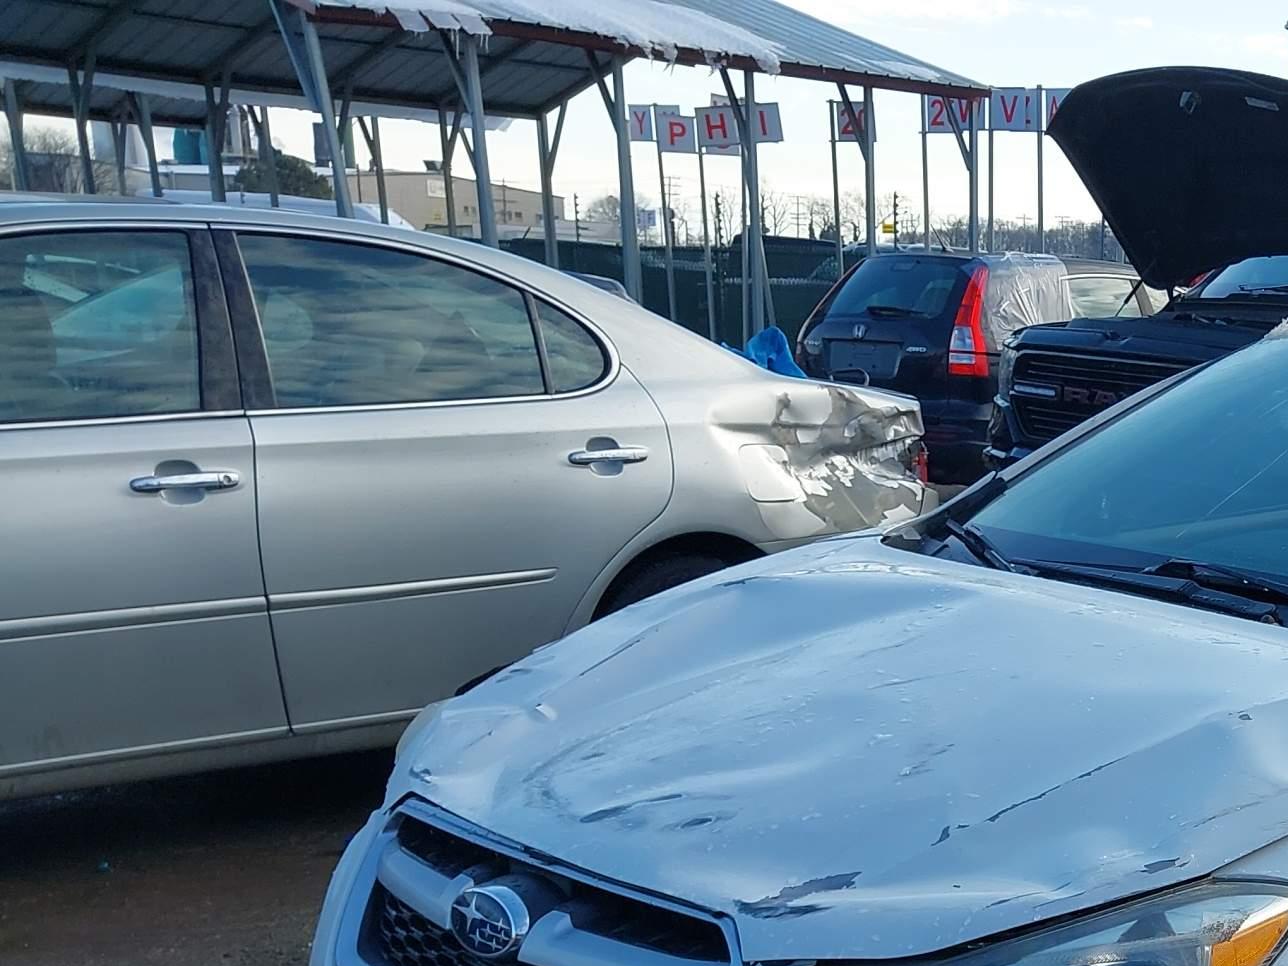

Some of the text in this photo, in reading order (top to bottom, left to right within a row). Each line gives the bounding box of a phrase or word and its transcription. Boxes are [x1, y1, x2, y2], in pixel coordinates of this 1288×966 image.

[1000, 95, 1019, 123] V
[633, 111, 646, 135] Y
[668, 121, 686, 145] P
[704, 110, 768, 139] H I
